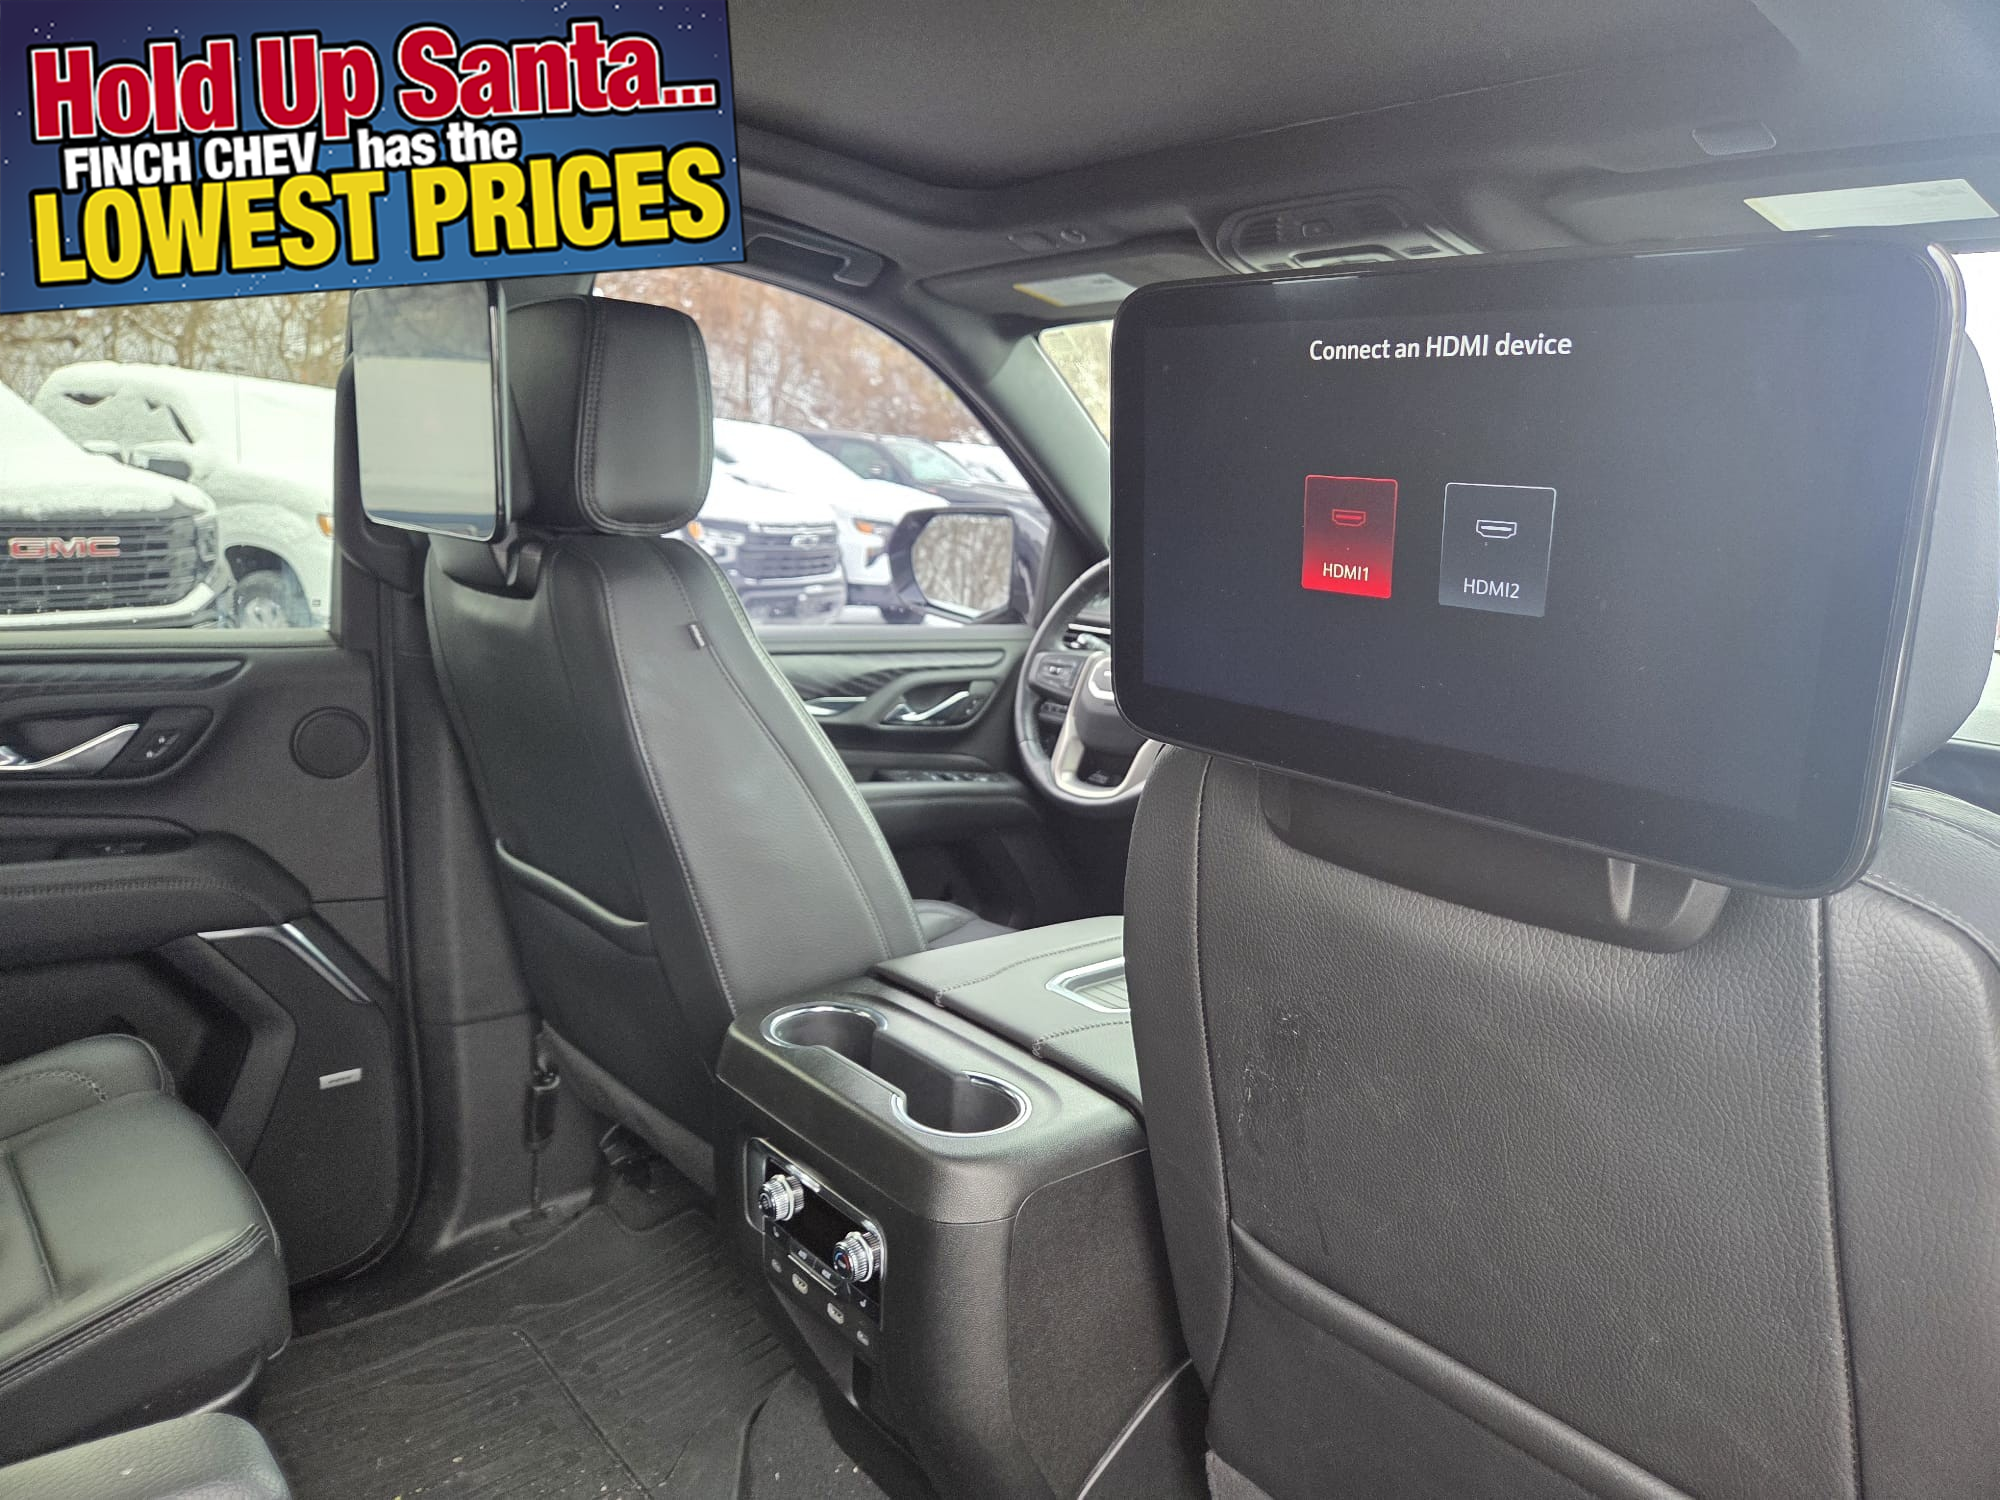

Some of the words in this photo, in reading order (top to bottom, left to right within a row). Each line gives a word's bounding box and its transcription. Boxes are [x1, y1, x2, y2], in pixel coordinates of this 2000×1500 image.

[1309, 338, 1391, 361] Connect
[1394, 342, 1420, 359] an
[1425, 333, 1489, 358] HDMI
[1494, 332, 1573, 357] device
[8, 535, 121, 559] GMC
[1322, 562, 1370, 583] HDMI1
[1463, 577, 1521, 600] HDMI2
